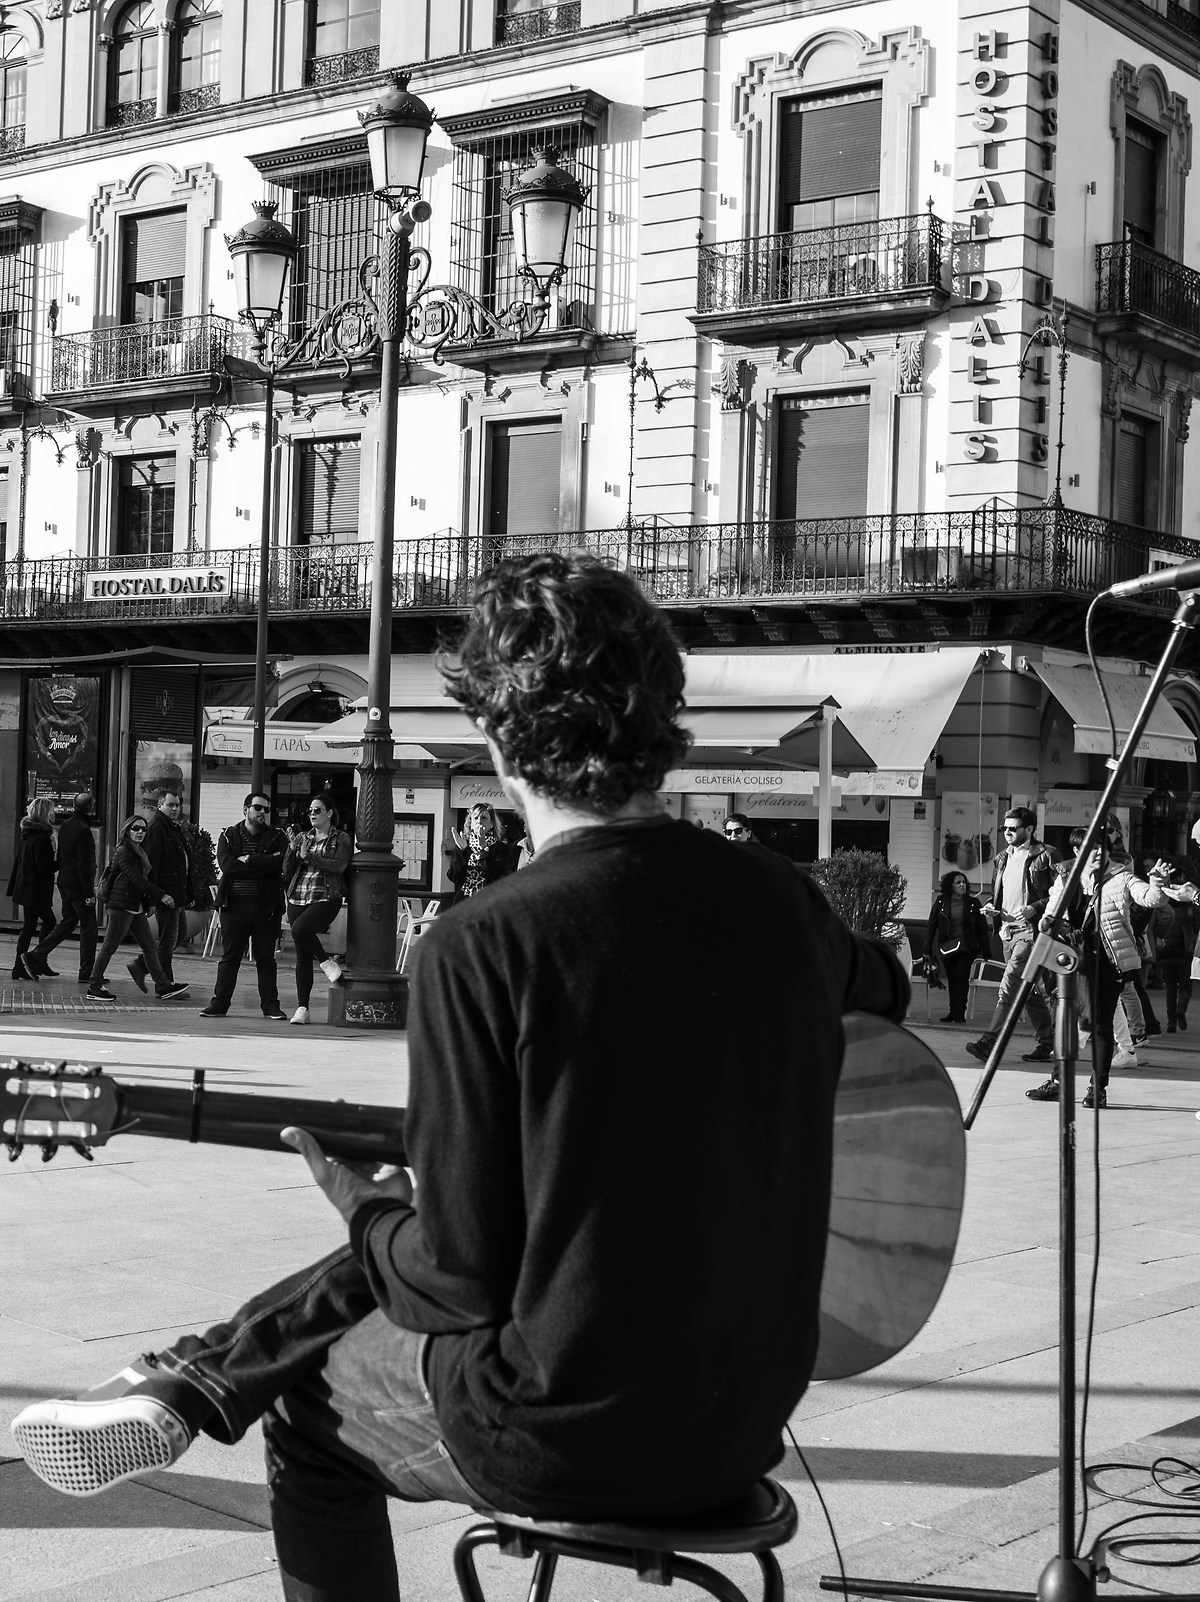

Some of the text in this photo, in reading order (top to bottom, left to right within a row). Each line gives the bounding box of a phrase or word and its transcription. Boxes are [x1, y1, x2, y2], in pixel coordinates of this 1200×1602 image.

[1038, 32, 1058, 248] HOSTAL
[964, 29, 997, 461] HOSTAL DALIS
[91, 571, 225, 597] HOSTAL DALÍS
[273, 737, 311, 752] TAPAS
[695, 774, 783, 785] GELATERÍA COLISEO
